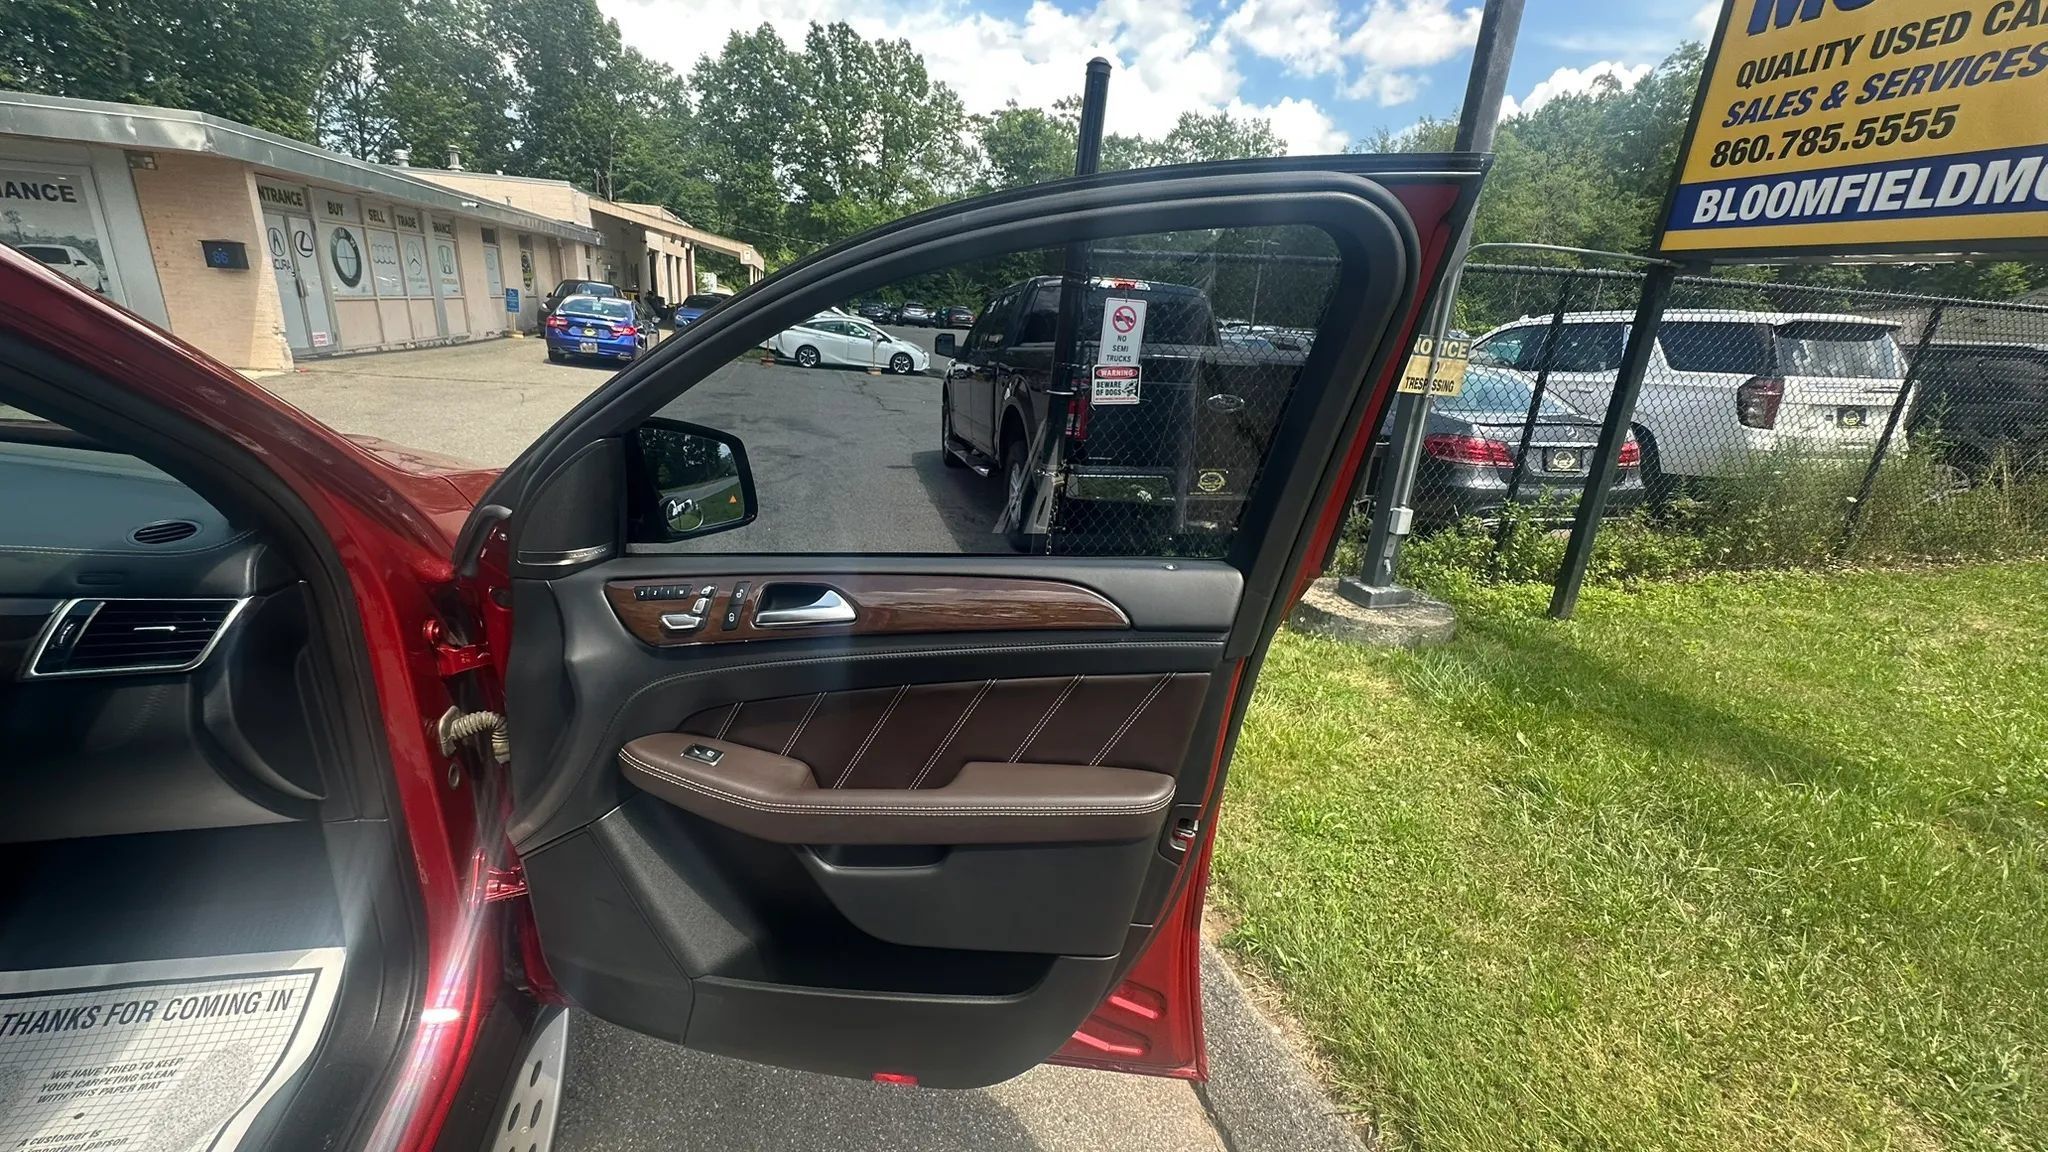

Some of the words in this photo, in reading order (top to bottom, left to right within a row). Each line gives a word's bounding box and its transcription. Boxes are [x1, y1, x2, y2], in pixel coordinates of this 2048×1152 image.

[1736, 33, 1865, 90] QUALITY
[1869, 10, 1972, 59] USED
[1983, 0, 2048, 36] CA
[1722, 85, 1819, 129] SALES
[1820, 79, 1849, 112] &
[1855, 41, 2048, 105] SERVICES
[1710, 104, 1961, 169] 860.785.5555
[0, 181, 77, 203] ANCE
[257, 184, 304, 207] NTRANCE
[1692, 155, 2048, 224] BLOOMFIELDM
[327, 201, 344, 216] BUY
[368, 208, 385, 223] SELL
[396, 214, 417, 229] TRADE
[1106, 354, 1131, 362] TRUCKS
[1414, 337, 1469, 360] NOICE
[1100, 369, 1134, 377] WARNING
[1405, 376, 1455, 393] TRESPSSING
[0, 1005, 102, 1037] THANKS
[103, 1000, 158, 1026] FOR
[162, 991, 262, 1021] COMING
[266, 989, 294, 1012] IN
[51, 1070, 71, 1080] WE
[71, 1067, 103, 1078] HAVE
[105, 1063, 138, 1075] TRIED
[140, 1060, 154, 1070] TO
[155, 1057, 184, 1068] KEEP
[38, 1092, 69, 1103] WITH
[70, 1088, 98, 1099] THIS
[98, 1085, 137, 1096] PAPER
[137, 1080, 164, 1091] MAT
[41, 1081, 74, 1092] YOUR
[75, 1073, 139, 1089] CARPETING
[140, 1069, 177, 1081] CLEAN
[17, 1138, 28, 1147] A
[30, 1131, 89, 1146] customer
[84, 1138, 128, 1152] person
